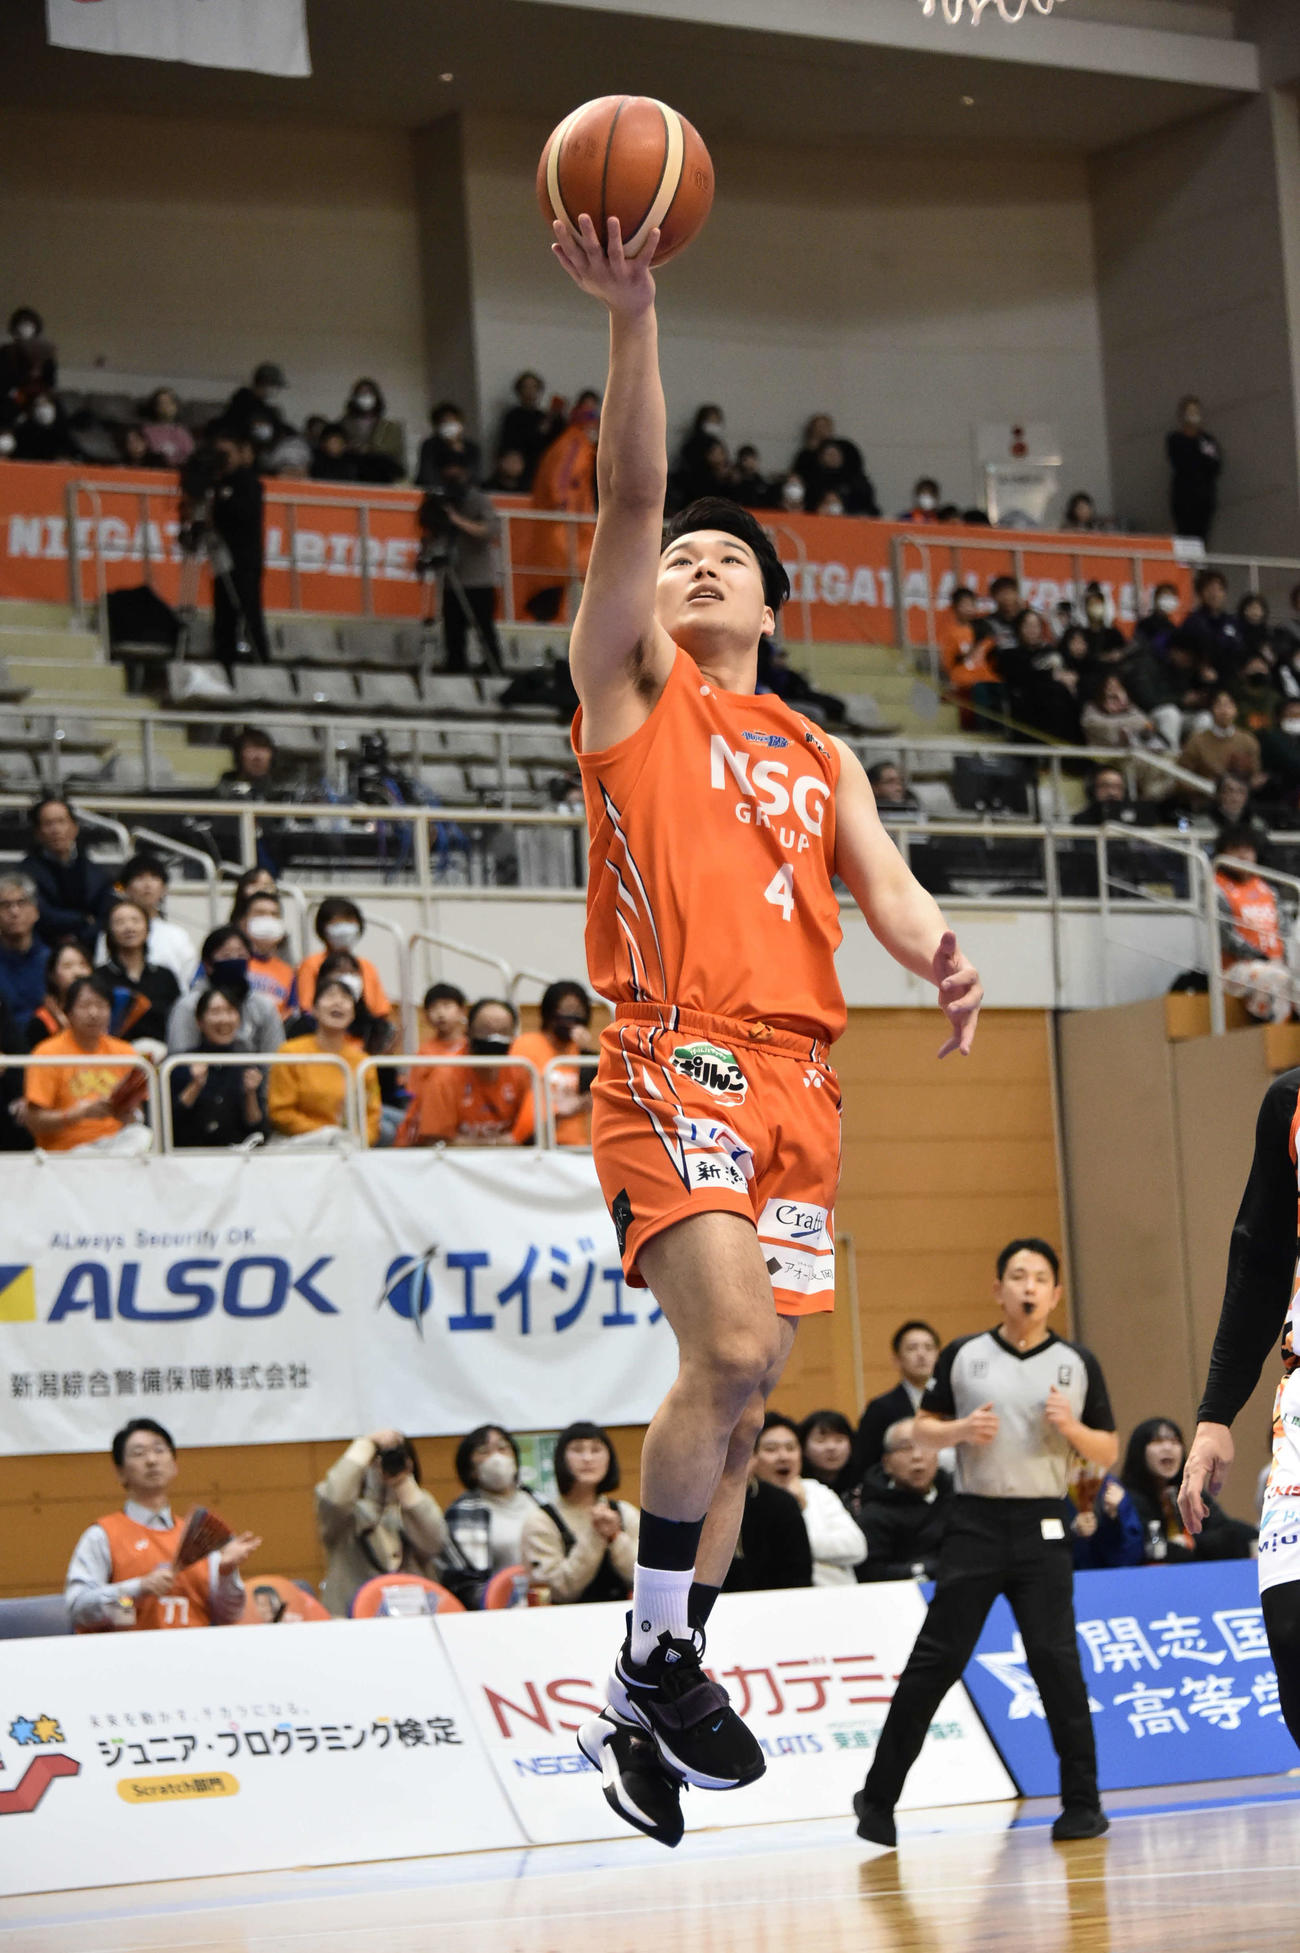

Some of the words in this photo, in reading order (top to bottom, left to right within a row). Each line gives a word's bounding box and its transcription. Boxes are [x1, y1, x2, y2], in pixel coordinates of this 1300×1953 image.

[710, 734, 831, 838] NSG
[735, 802, 810, 854] GRUP
[763, 862, 794, 922] 4
[228, 1227, 257, 1246] OK
[48, 1256, 340, 1323] ALSOK
[446, 1236, 664, 1335] エイジェ
[97, 1715, 463, 1768] ジュニア・プログラミング検定
